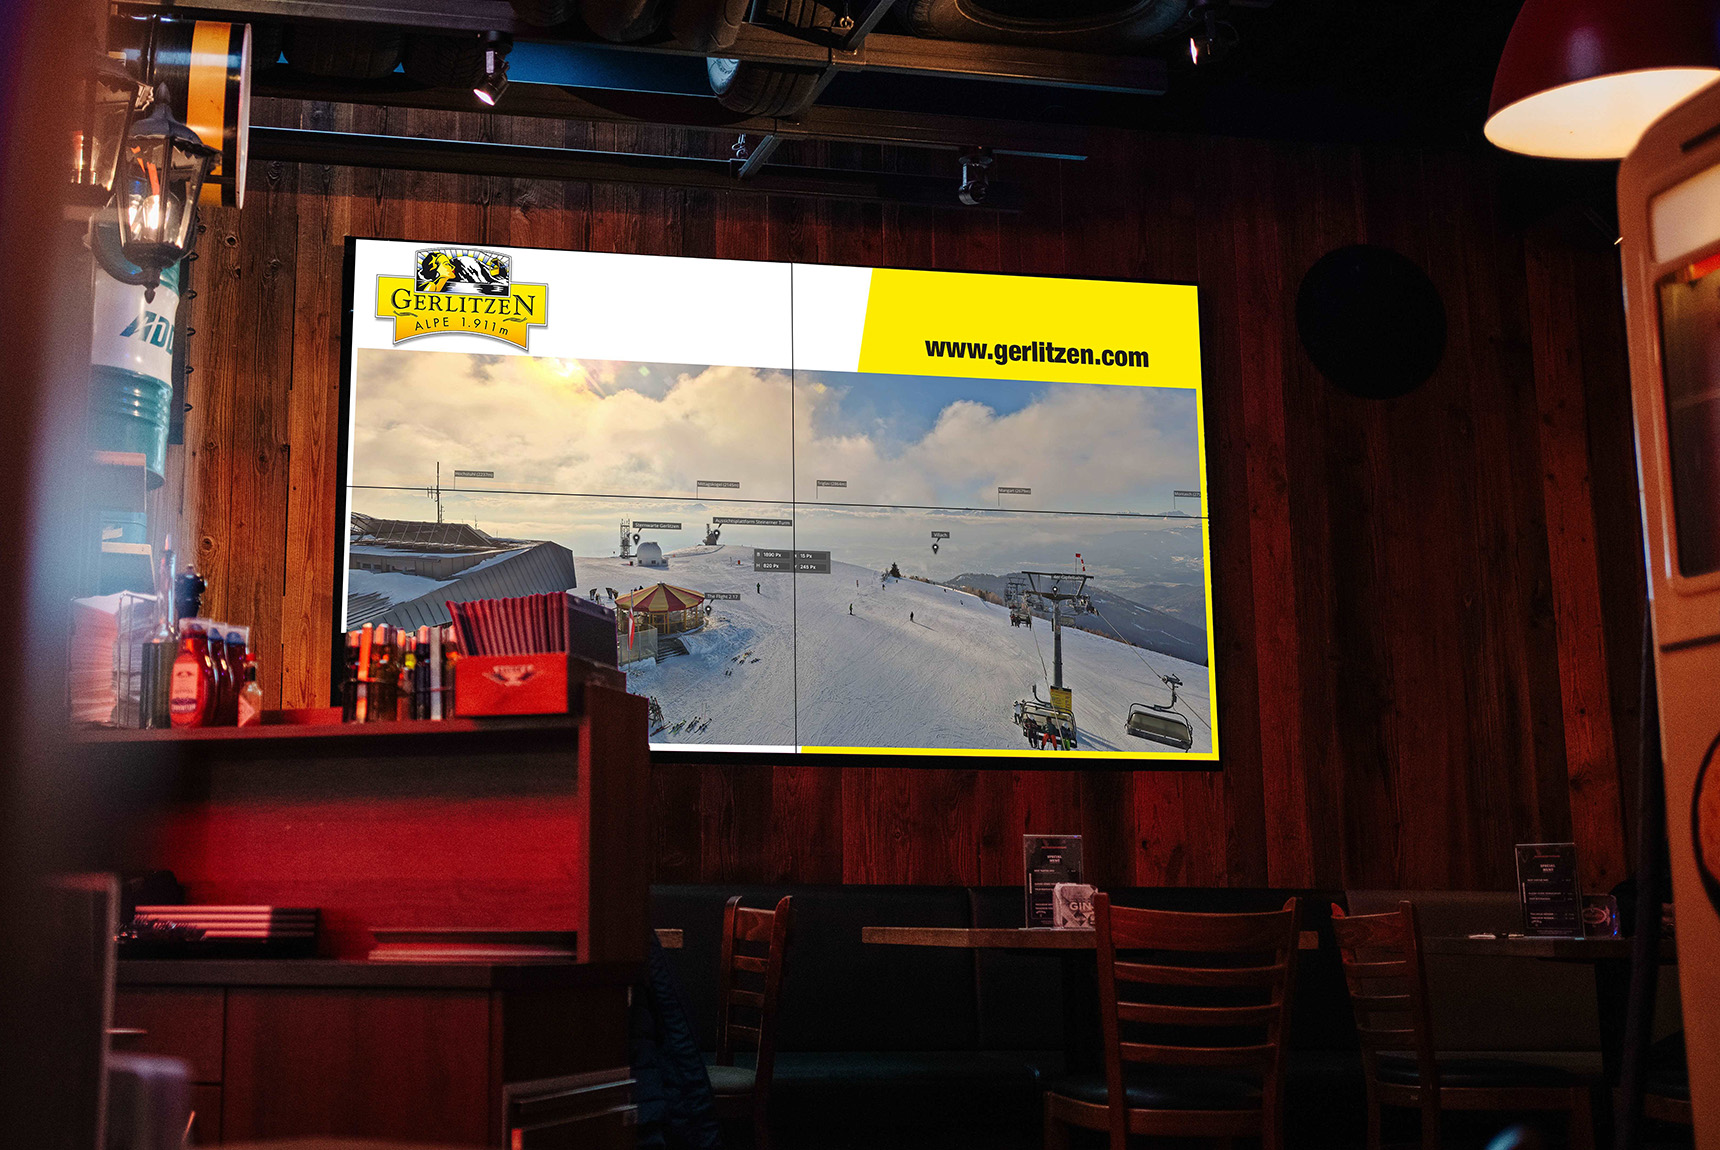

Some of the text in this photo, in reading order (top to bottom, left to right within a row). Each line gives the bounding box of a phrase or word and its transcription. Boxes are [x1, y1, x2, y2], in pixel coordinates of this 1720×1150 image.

[391, 288, 536, 316] GERLITZEN
[415, 317, 509, 336] ALPE 1.911m
[925, 340, 1149, 367] www.gerlitzen.com
